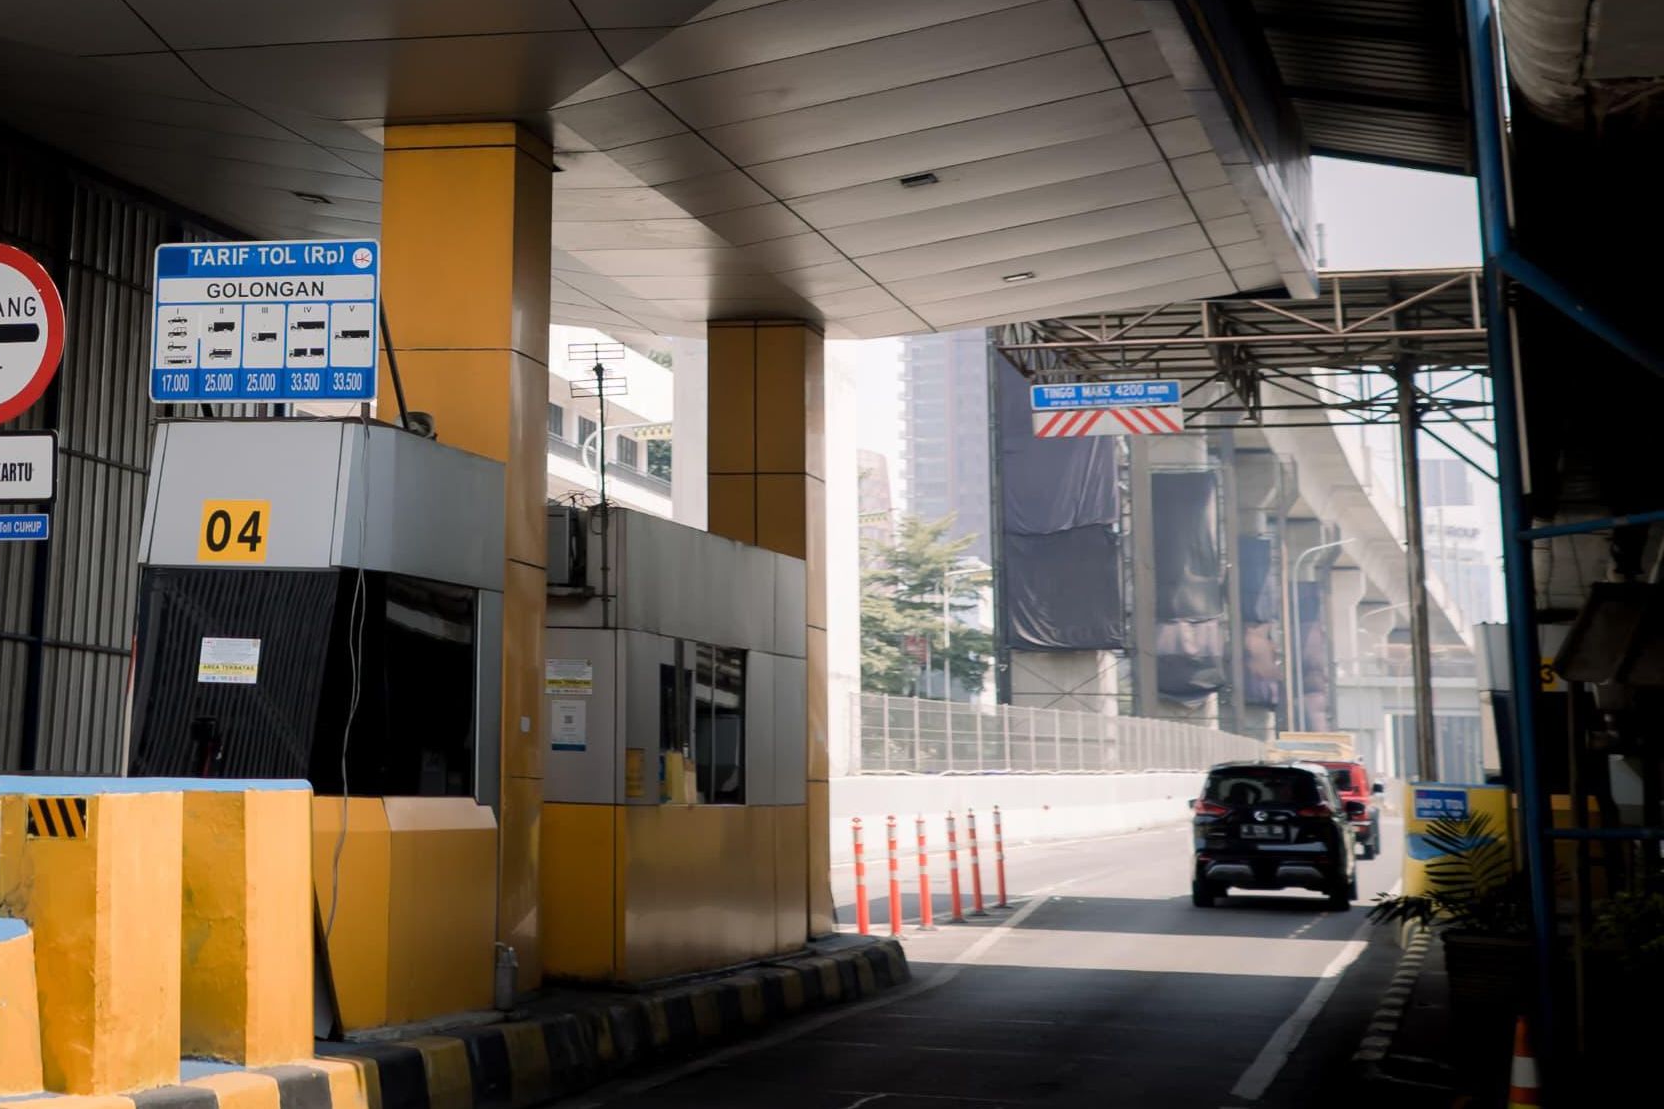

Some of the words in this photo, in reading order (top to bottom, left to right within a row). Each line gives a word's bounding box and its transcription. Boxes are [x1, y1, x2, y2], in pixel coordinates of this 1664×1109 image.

[191, 247, 249, 266] TARIF
[258, 246, 296, 265] TOL
[304, 245, 345, 266] (Rp)
[207, 281, 325, 299] GOLONGAN
[162, 374, 189, 392] 17.000
[205, 374, 233, 392] 25.000
[247, 373, 276, 391] 25.000
[291, 372, 320, 391] 33.500
[333, 372, 362, 391] 33.500
[1043, 387, 1075, 399] TINGGI
[1082, 386, 1111, 398] MAKS
[1115, 384, 1144, 396] 4200
[205, 509, 262, 552] 04
